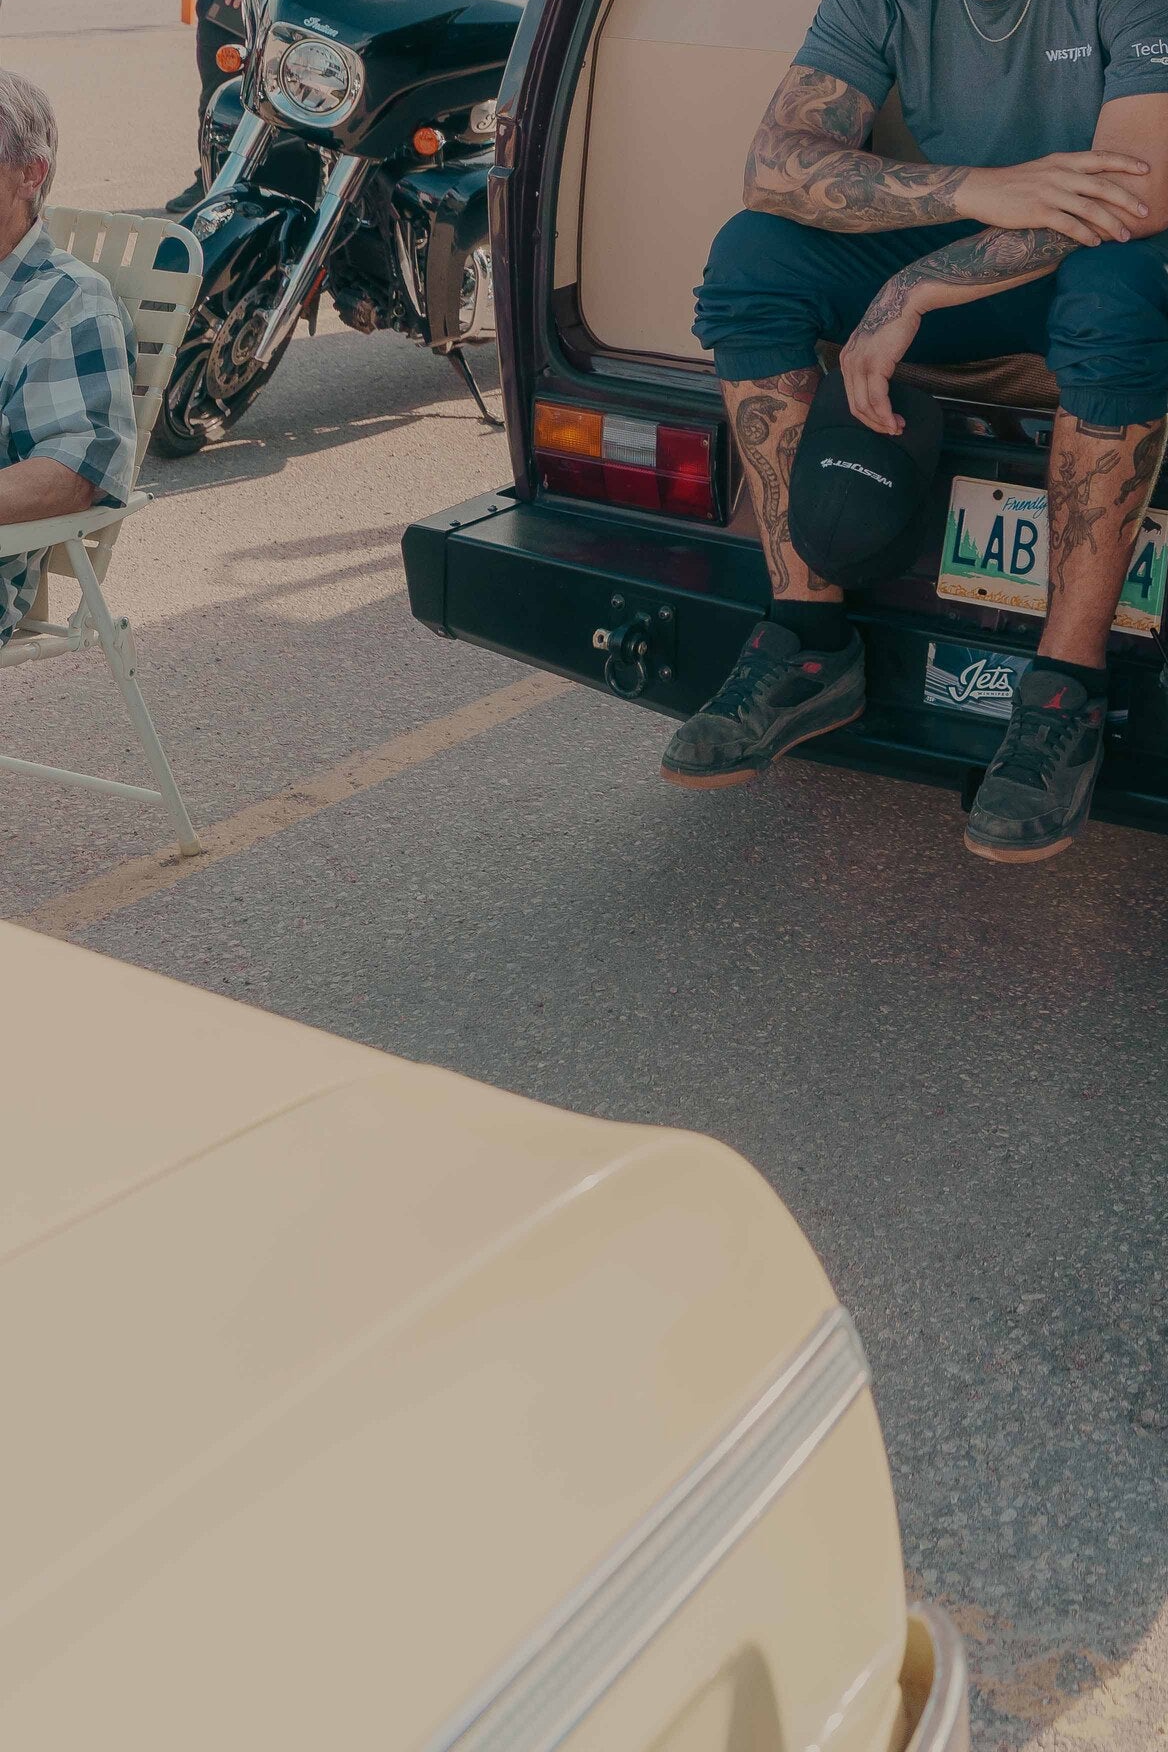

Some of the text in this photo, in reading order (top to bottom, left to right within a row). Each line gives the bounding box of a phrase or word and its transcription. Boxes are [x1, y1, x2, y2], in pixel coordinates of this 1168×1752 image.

[1045, 46, 1088, 63] WESTJET
[1132, 39, 1168, 58] Tech
[832, 459, 893, 488] WESTJET
[1001, 494, 1049, 519] Friendly
[951, 508, 1039, 576] LAB
[948, 659, 1014, 702] Jets
